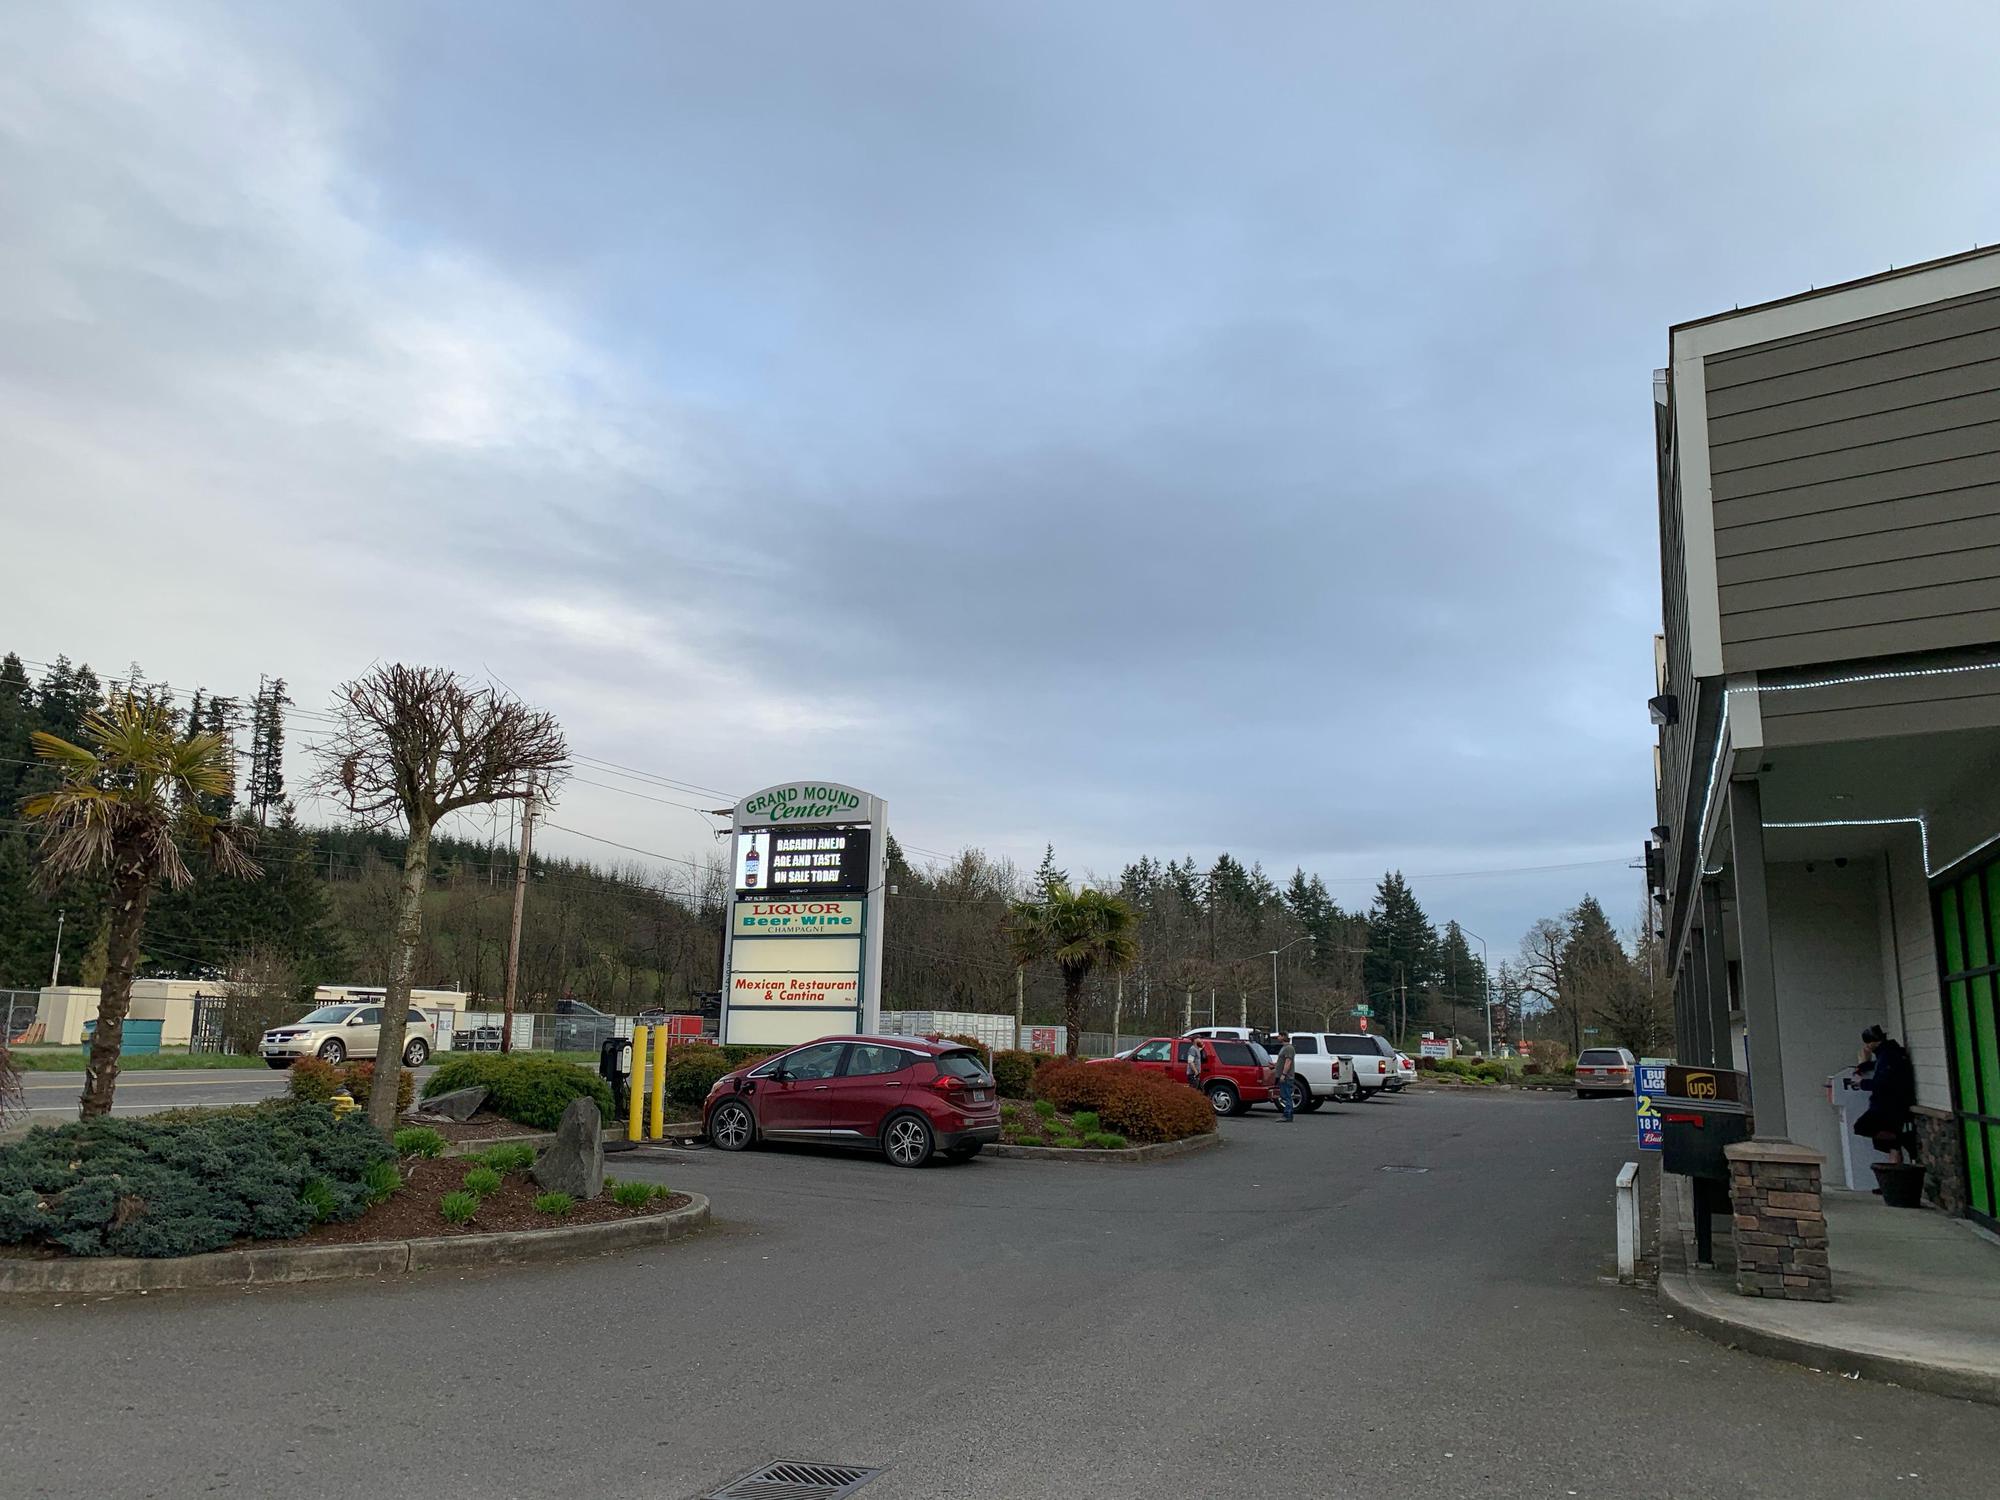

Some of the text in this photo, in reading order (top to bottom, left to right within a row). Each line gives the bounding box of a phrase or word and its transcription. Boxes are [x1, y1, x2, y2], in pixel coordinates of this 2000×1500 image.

[746, 787, 860, 814] GRAND MOUND
[770, 802, 838, 821] Center
[777, 838, 816, 851] BACARDI
[792, 854, 811, 866] AND
[812, 853, 841, 866] TASTE
[774, 869, 840, 883] ON SALE TODAY
[752, 903, 842, 915] LIQUOR
[743, 915, 853, 926] Beer Wine
[768, 926, 824, 934] CHAMPAGNE
[735, 979, 857, 990] Mexican Restaurant
[764, 990, 825, 1001] & Cantina
[1646, 1070, 1665, 1080] BU
[1843, 1078, 1860, 1091] Fe
[1689, 1083, 1715, 1101] ups
[1637, 1095, 1661, 1117] 2
[1640, 1118, 1651, 1130] 18
